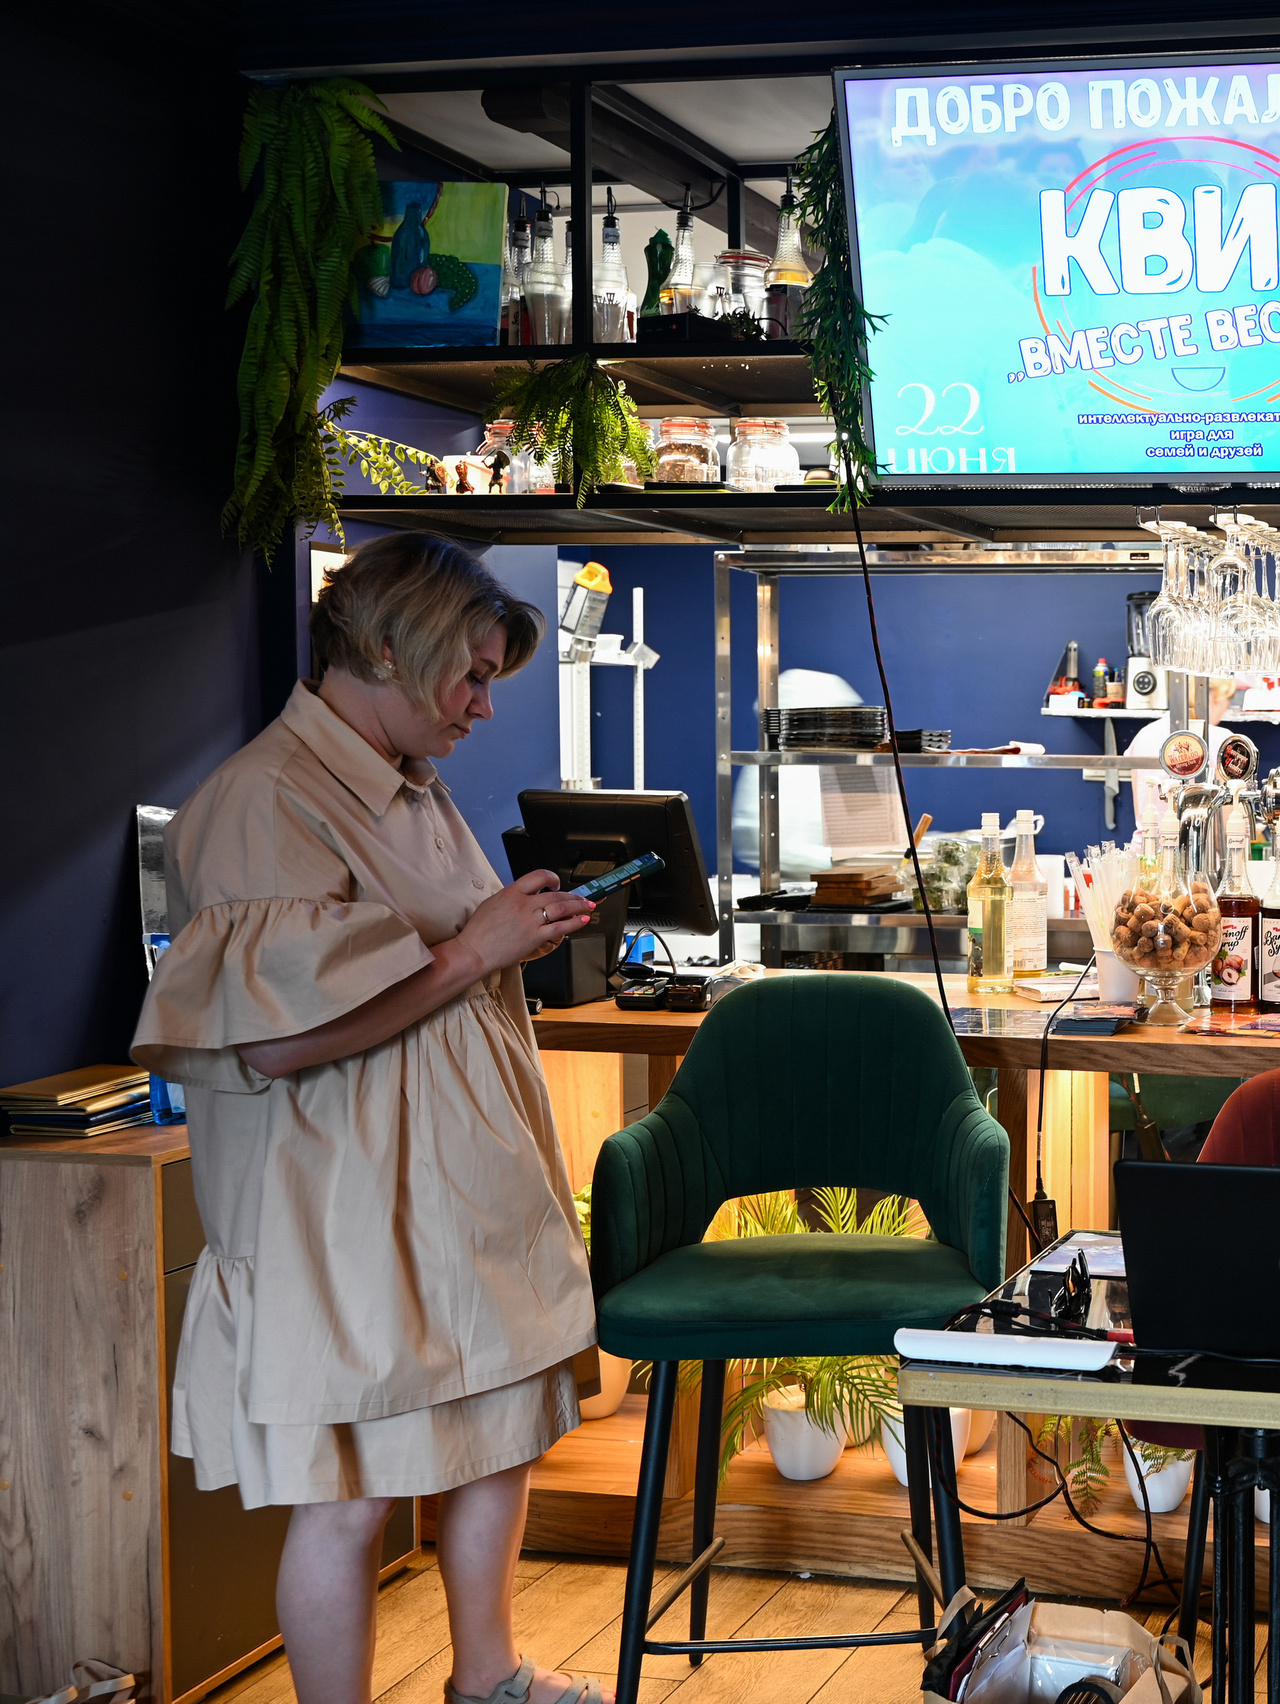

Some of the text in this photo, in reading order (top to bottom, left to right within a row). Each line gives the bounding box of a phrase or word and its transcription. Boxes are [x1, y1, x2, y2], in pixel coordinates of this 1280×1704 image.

[890, 83, 1071, 147] ДОБРО
[895, 382, 985, 436] 22
[1170, 429, 1234, 440] игра для
[1146, 443, 1263, 458] семей и друзей
[887, 446, 1017, 474] июня
[1169, 750, 1199, 764] WATERLOO
[1223, 925, 1249, 940] rinoff
[1219, 940, 1239, 952] yrup
